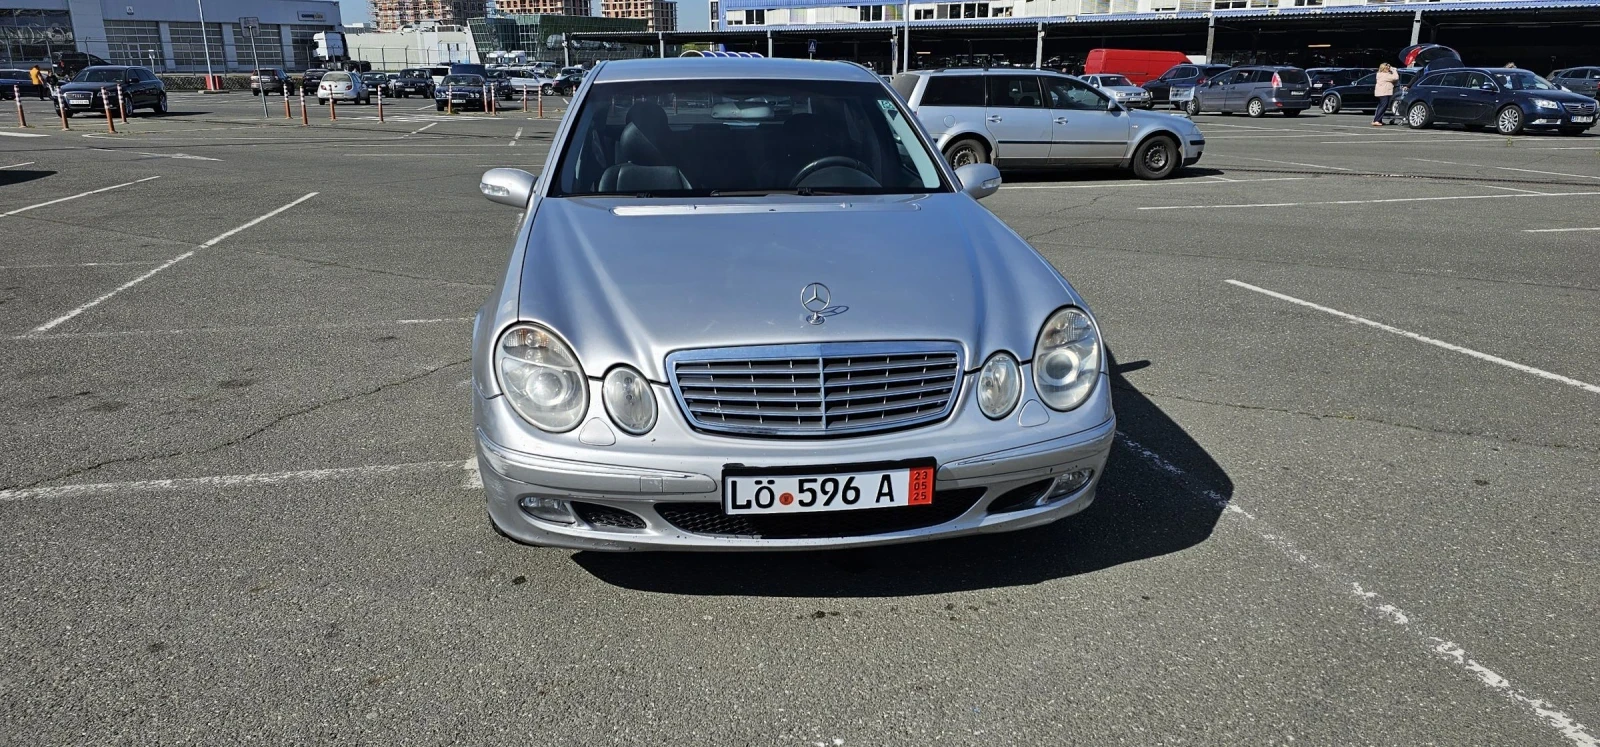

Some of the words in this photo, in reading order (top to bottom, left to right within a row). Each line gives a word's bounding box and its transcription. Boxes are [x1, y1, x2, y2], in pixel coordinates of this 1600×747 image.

[913, 470, 928, 480] 23
[913, 481, 927, 491] 05
[731, 479, 776, 510] LÖ
[798, 477, 861, 507] 596
[875, 474, 895, 503] A
[913, 491, 927, 501] 25
